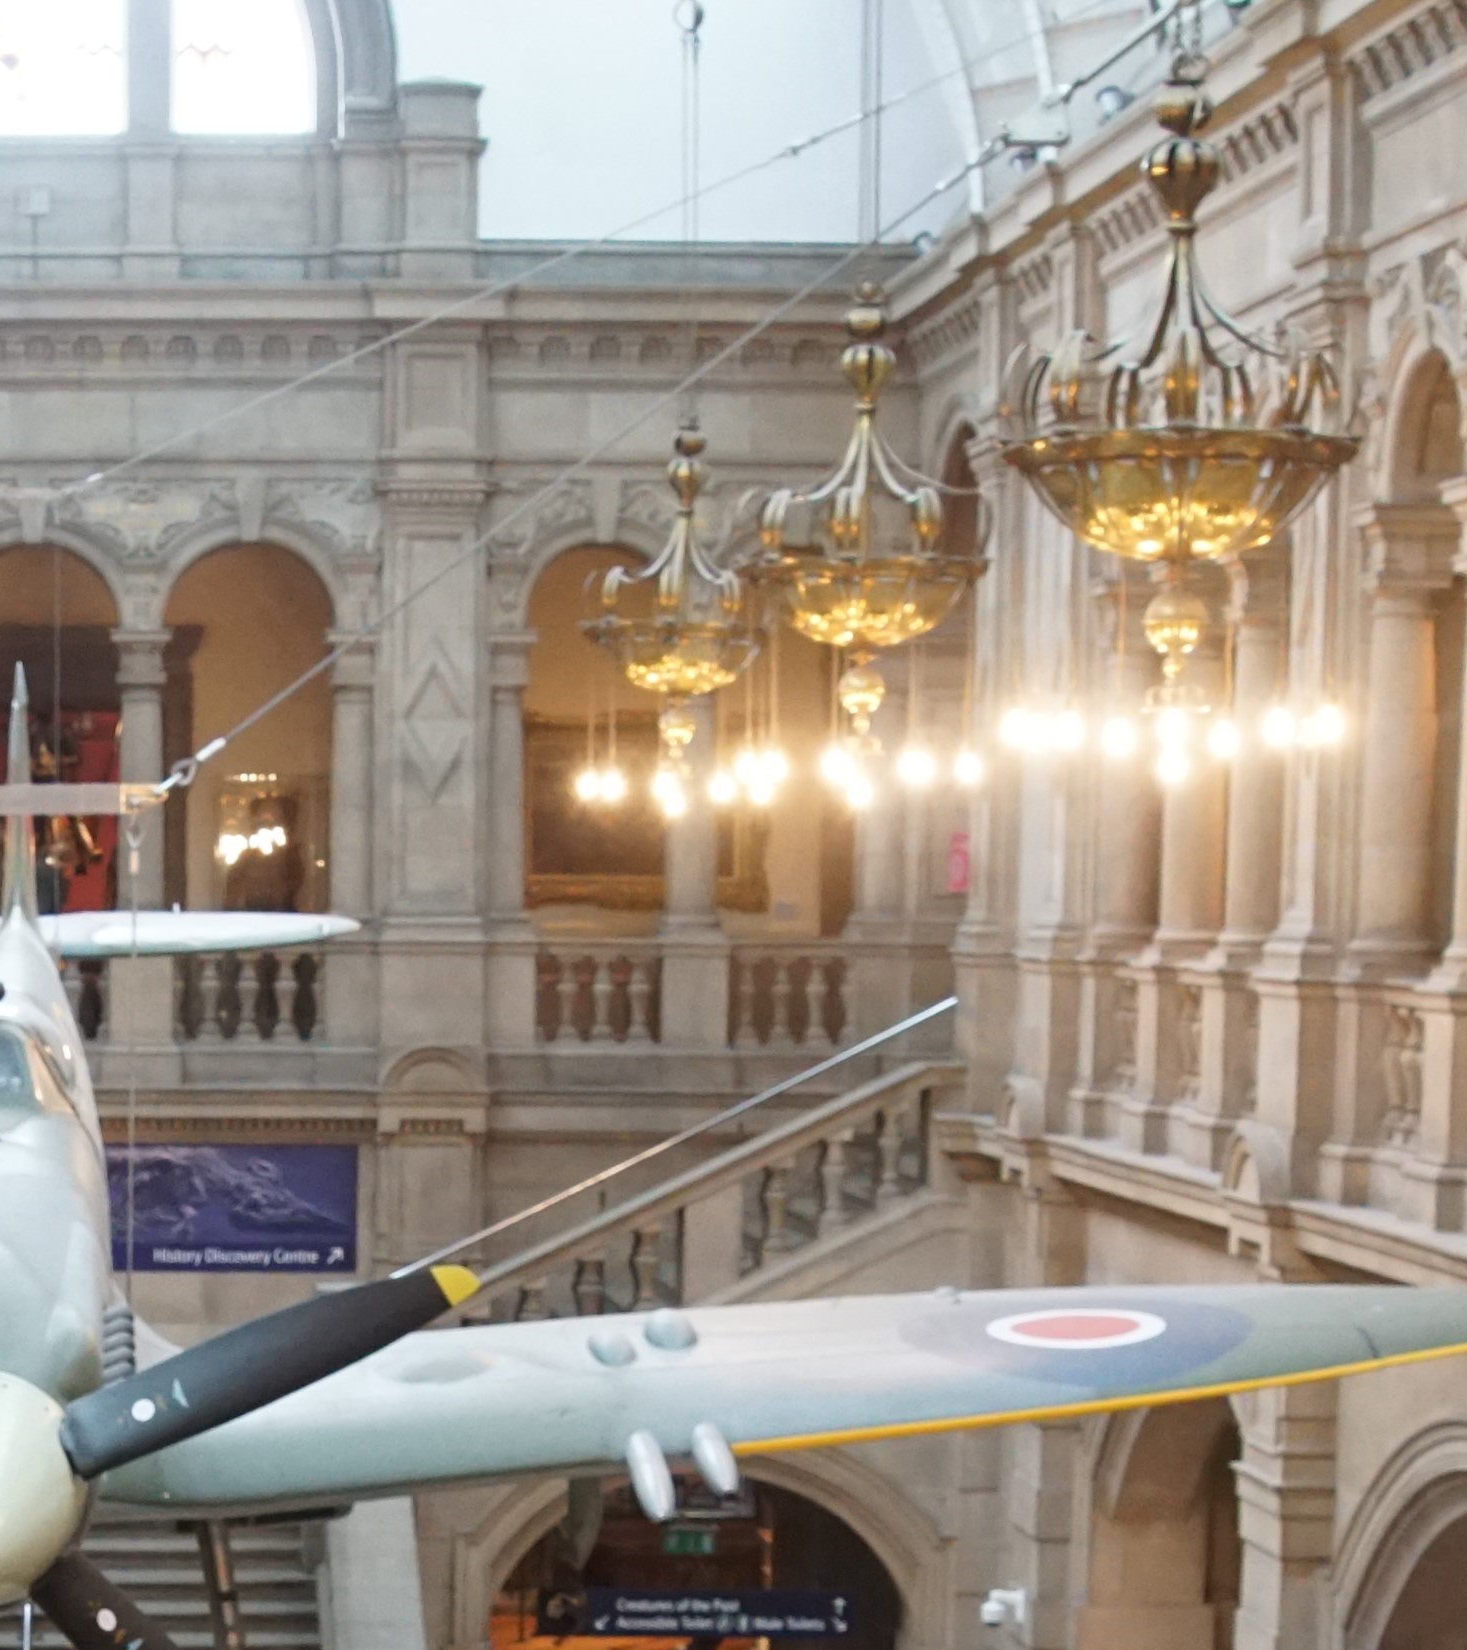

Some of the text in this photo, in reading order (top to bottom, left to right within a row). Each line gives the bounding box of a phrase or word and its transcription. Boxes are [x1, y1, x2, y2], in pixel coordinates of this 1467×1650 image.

[153, 1247, 320, 1266] History Discovery Centre
[616, 1597, 674, 1613] Creatures
